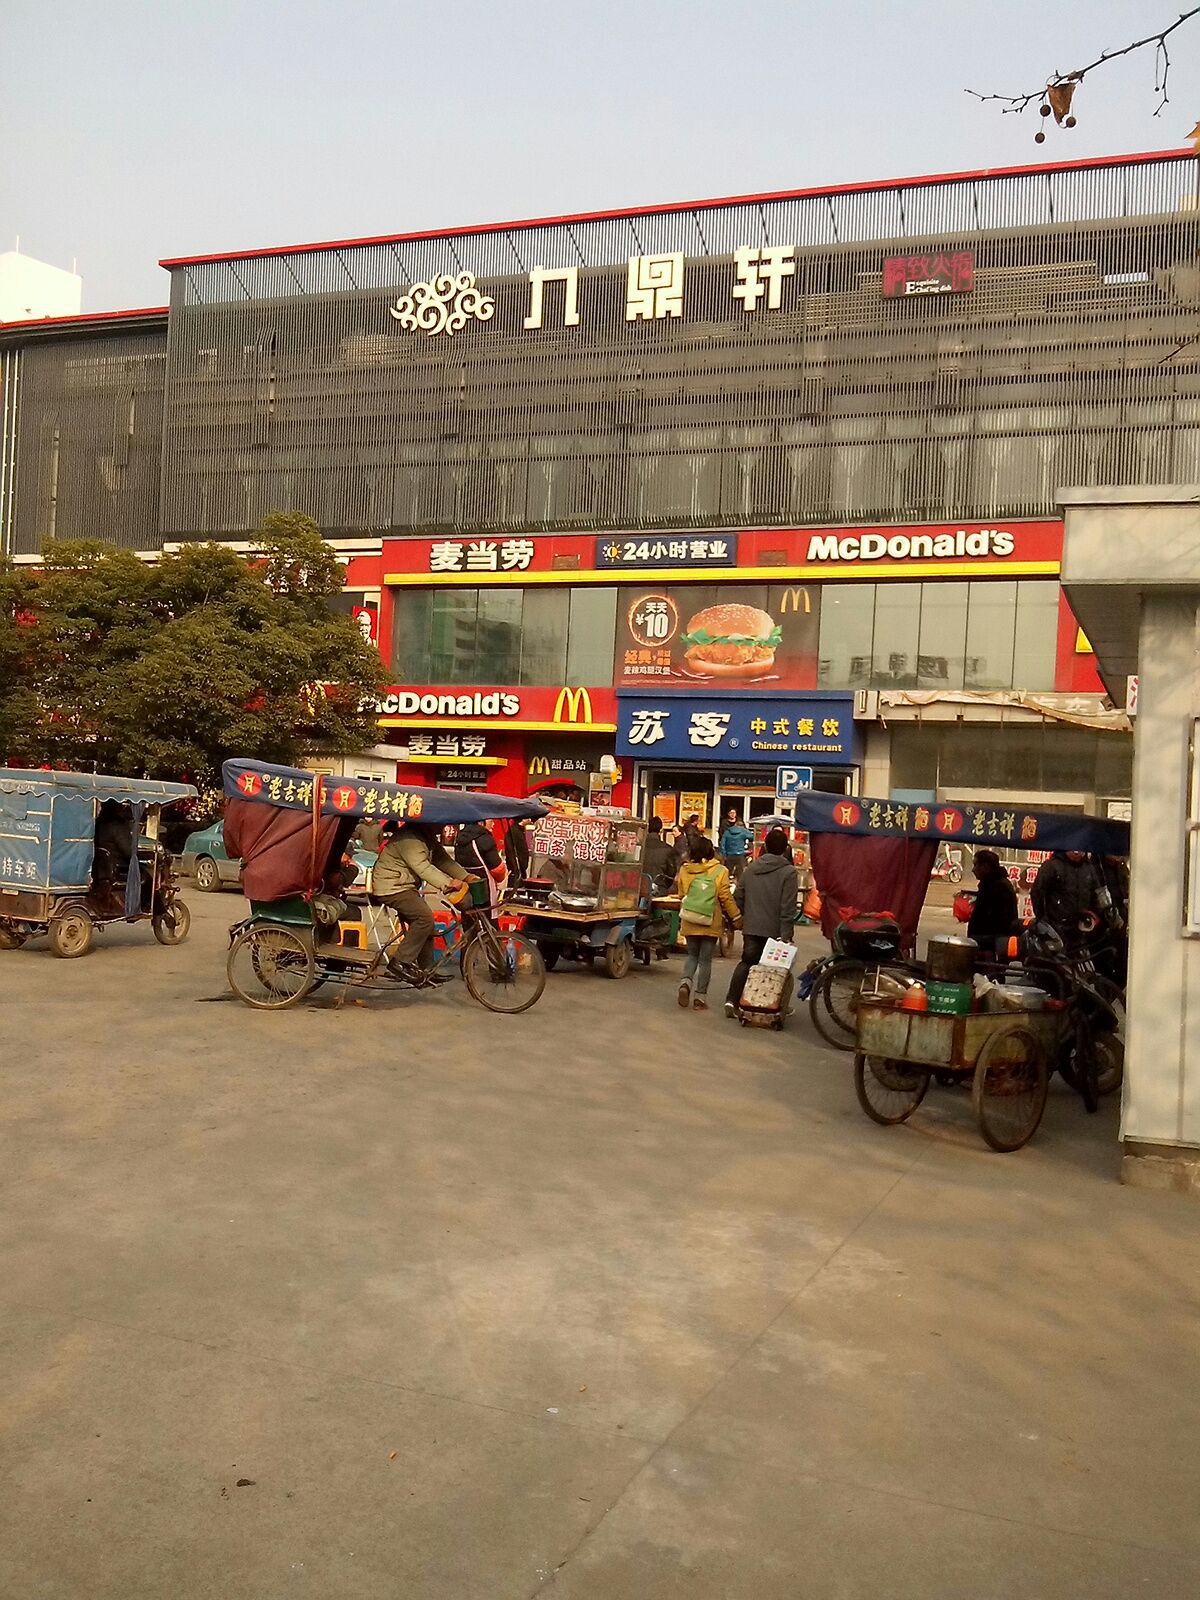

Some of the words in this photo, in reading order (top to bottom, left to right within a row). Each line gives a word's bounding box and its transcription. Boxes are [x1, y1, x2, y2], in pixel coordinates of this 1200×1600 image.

[429, 539, 534, 572] 麦当劳
[622, 540, 729, 561] 24小时营业
[806, 530, 1015, 562] McDonald's
[645, 602, 668, 613] 天天
[628, 710, 731, 747] 苏客
[751, 718, 840, 737] 中式餐饮
[408, 733, 487, 757] 麦当劳
[752, 741, 788, 750] Chinese
[792, 742, 842, 752] restaurant
[551, 759, 587, 771] 甜品站
[781, 769, 799, 791] P
[533, 816, 609, 845] 鸡蛋煎饼
[534, 837, 566, 857] 面条
[573, 841, 607, 864] 馄饨
